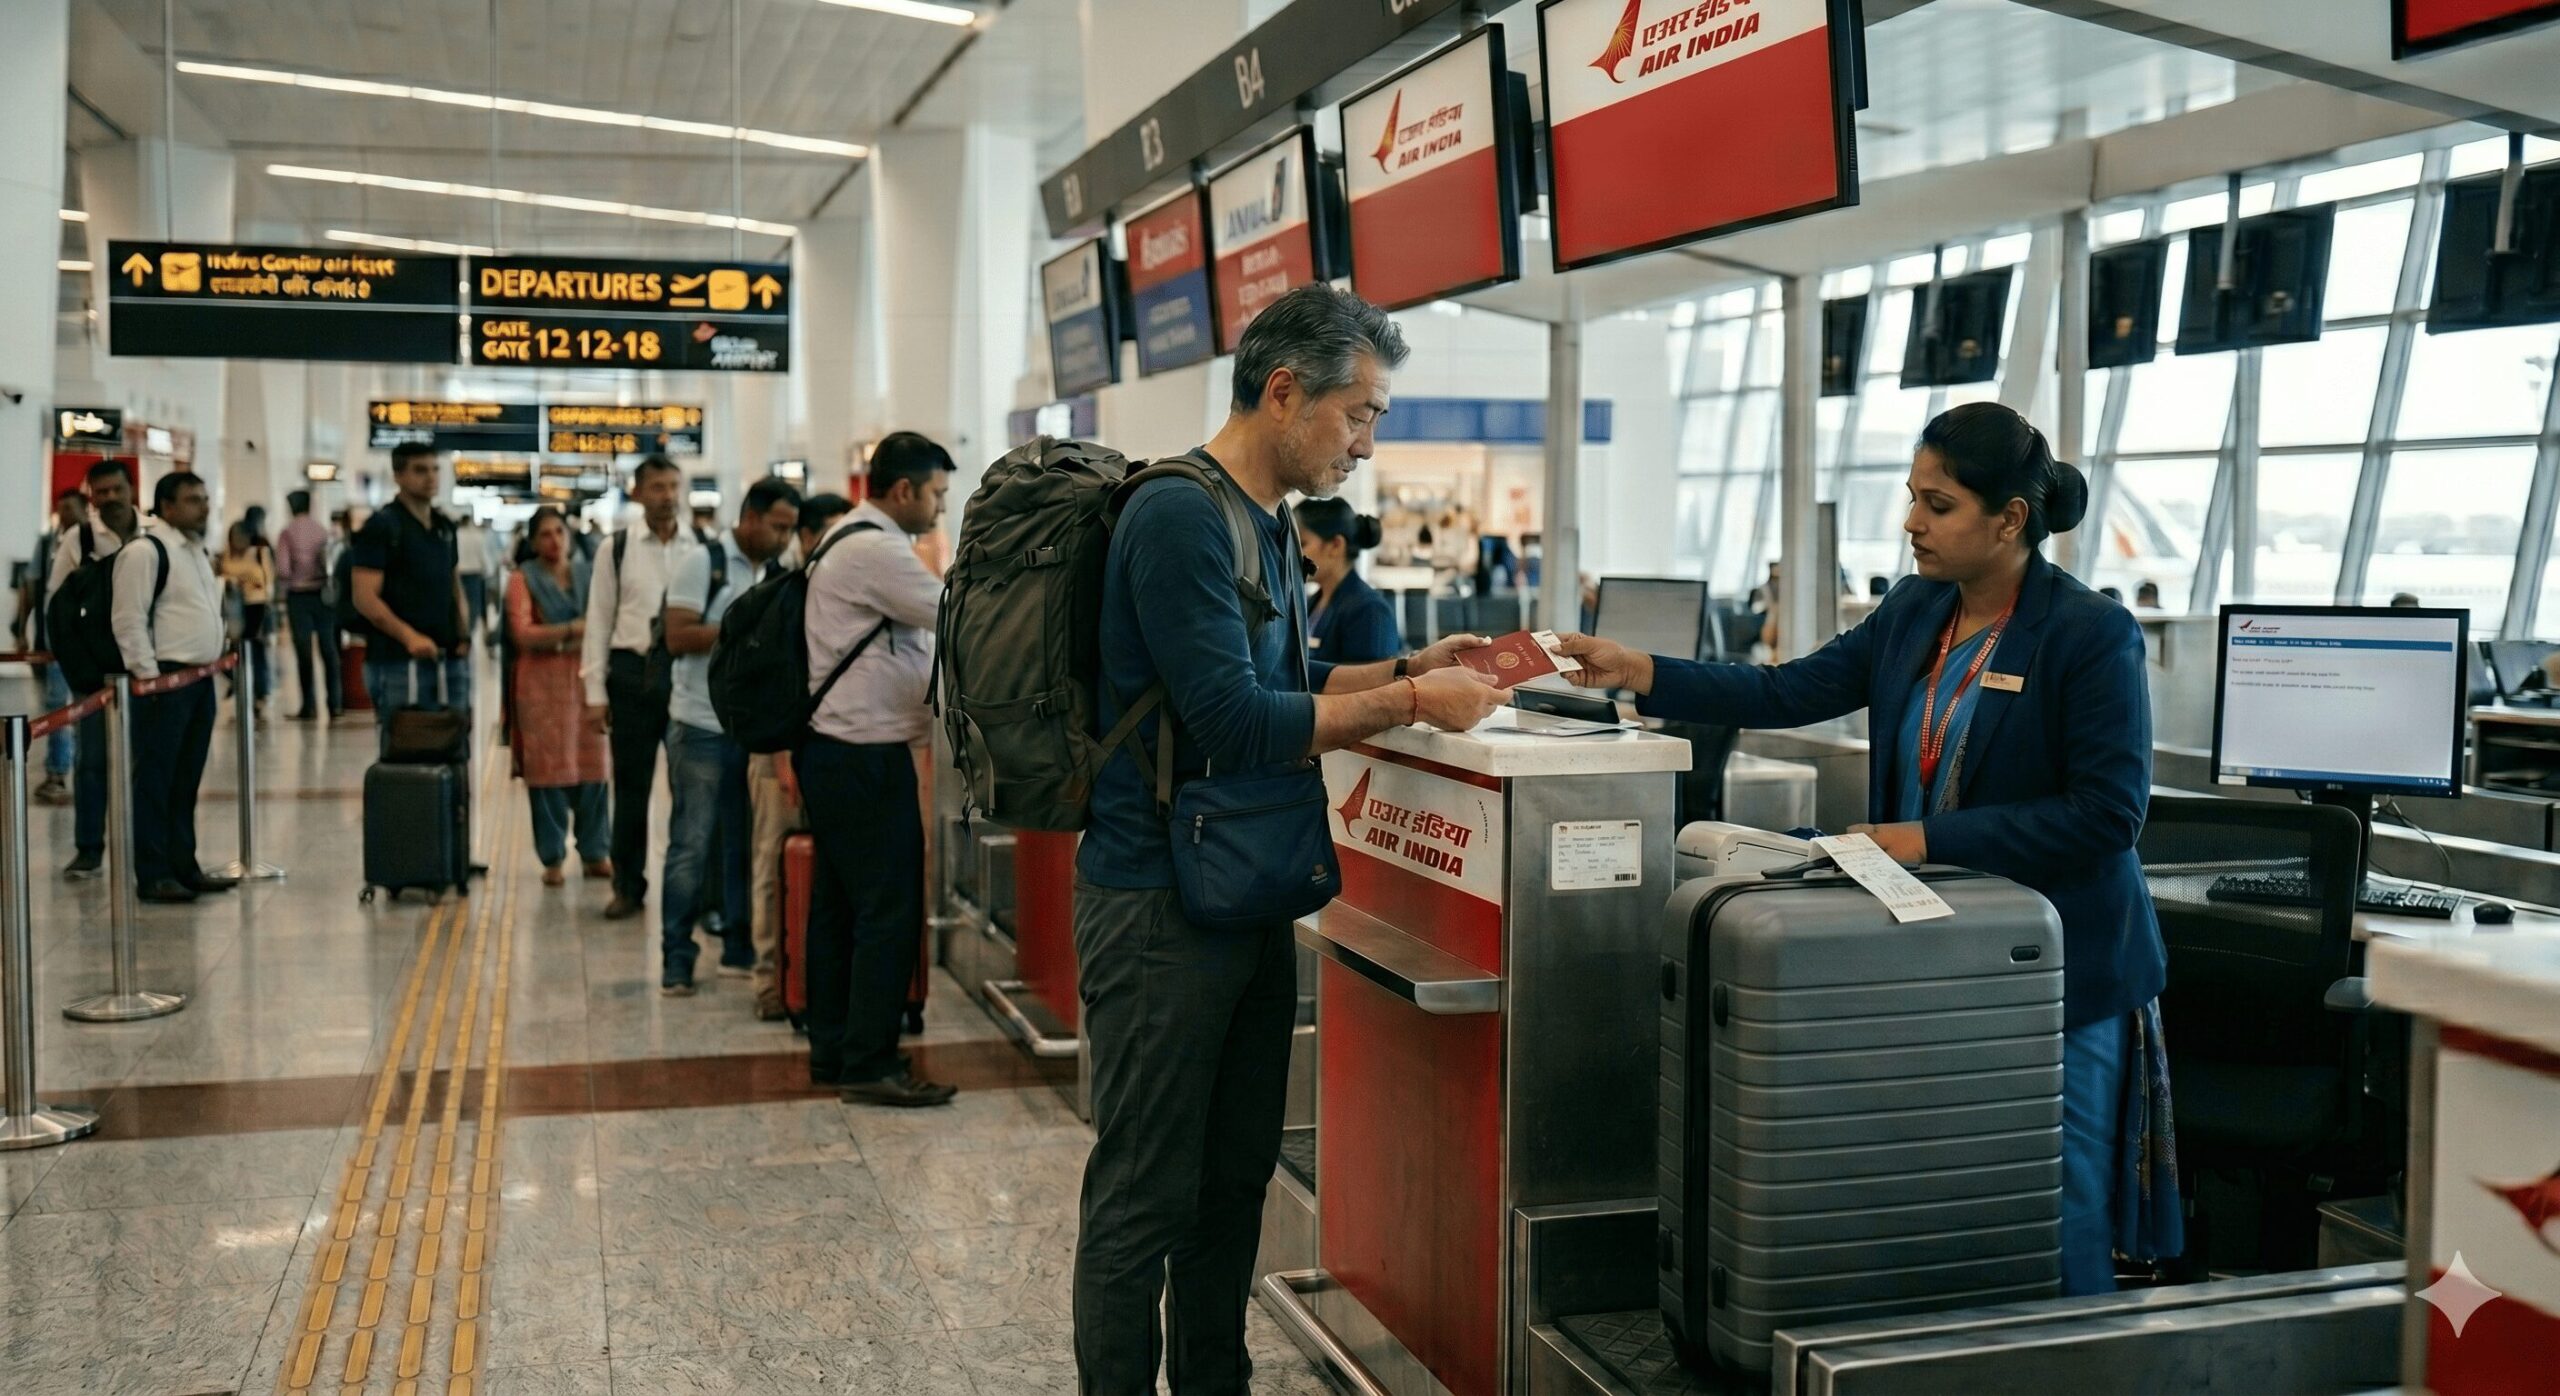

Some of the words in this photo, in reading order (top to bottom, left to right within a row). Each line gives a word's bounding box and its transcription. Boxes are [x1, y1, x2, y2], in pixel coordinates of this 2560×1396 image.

[1638, 43, 1682, 78] AIR
[1686, 12, 1760, 59] INDIA
[1234, 47, 1265, 109] B4
[1398, 147, 1420, 169] AIR
[1423, 129, 1462, 158] INDIA
[480, 268, 663, 301] DEPARTURES
[482, 320, 531, 338] GATE
[534, 328, 571, 359] 12
[576, 329, 661, 360] 12-18
[1364, 826, 1400, 853] AIR
[1402, 839, 1464, 878] INDIA
